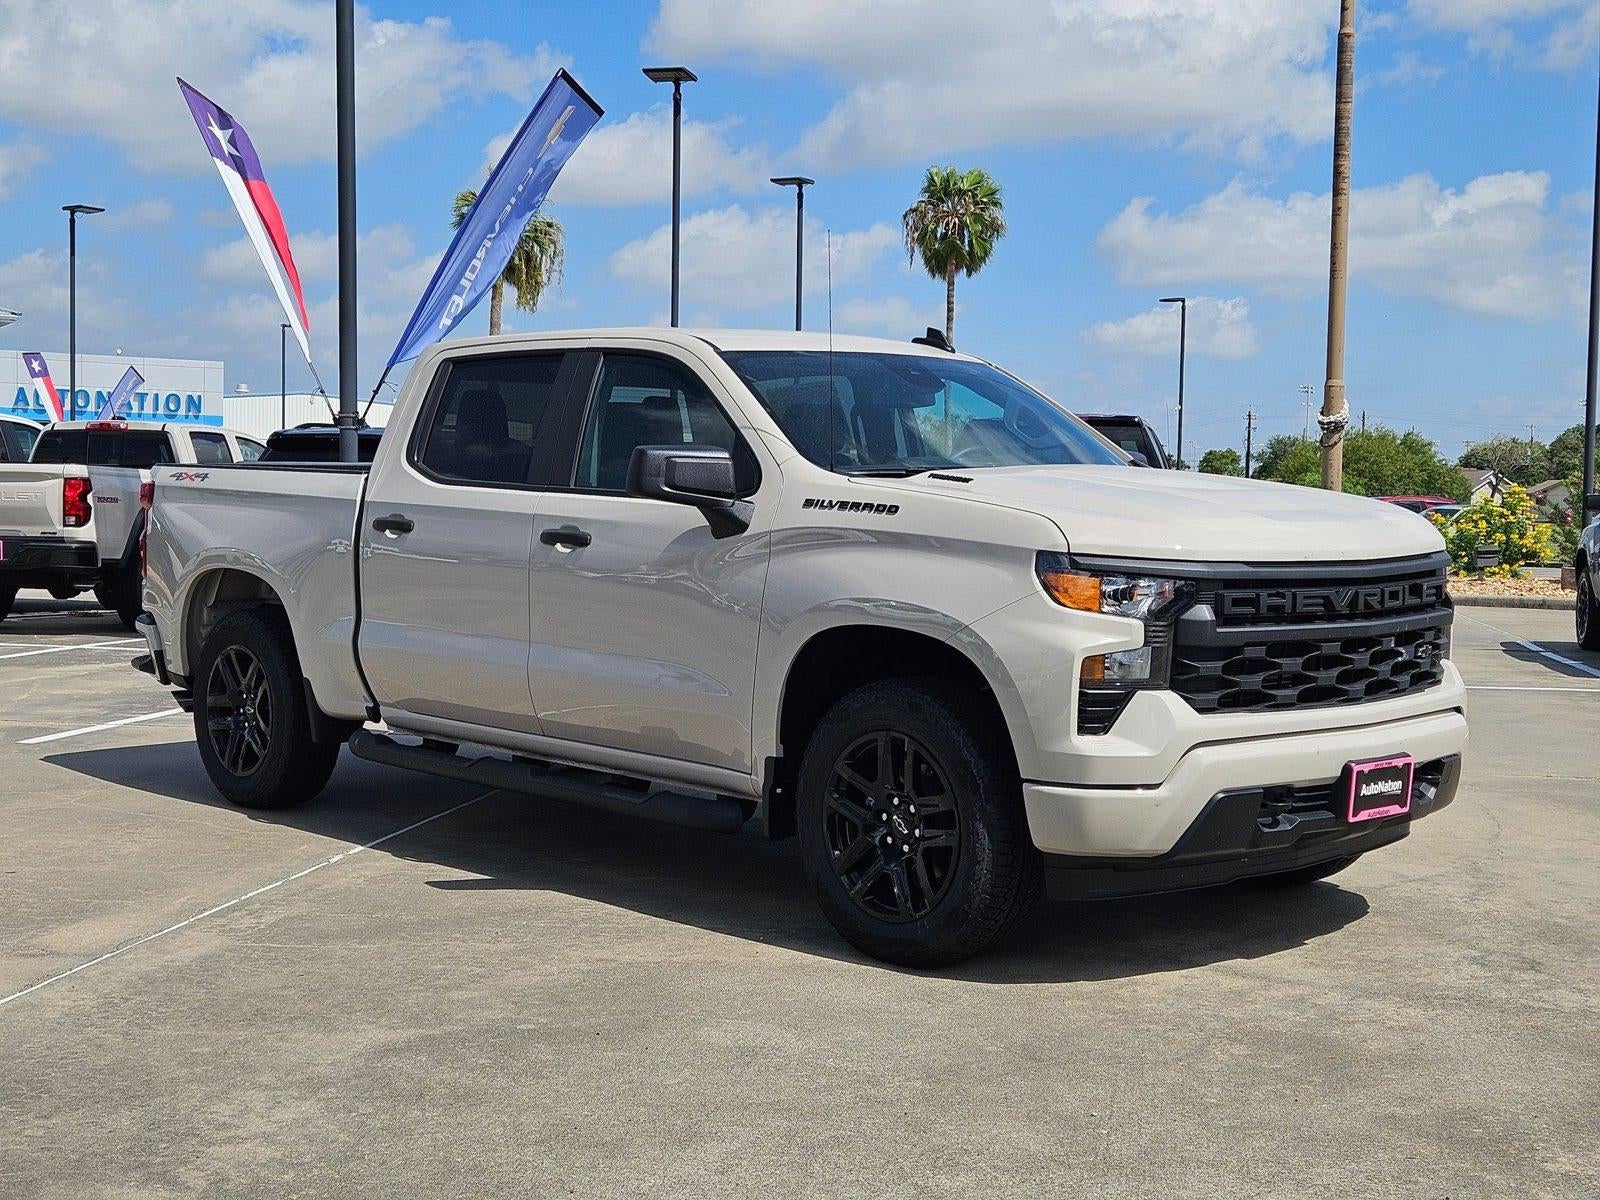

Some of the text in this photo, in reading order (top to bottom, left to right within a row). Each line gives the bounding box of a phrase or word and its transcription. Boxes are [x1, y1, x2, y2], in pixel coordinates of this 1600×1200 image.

[0, 491, 43, 501] LET
[802, 498, 900, 516] SILVERADO
[1360, 779, 1403, 797] AutoNation
